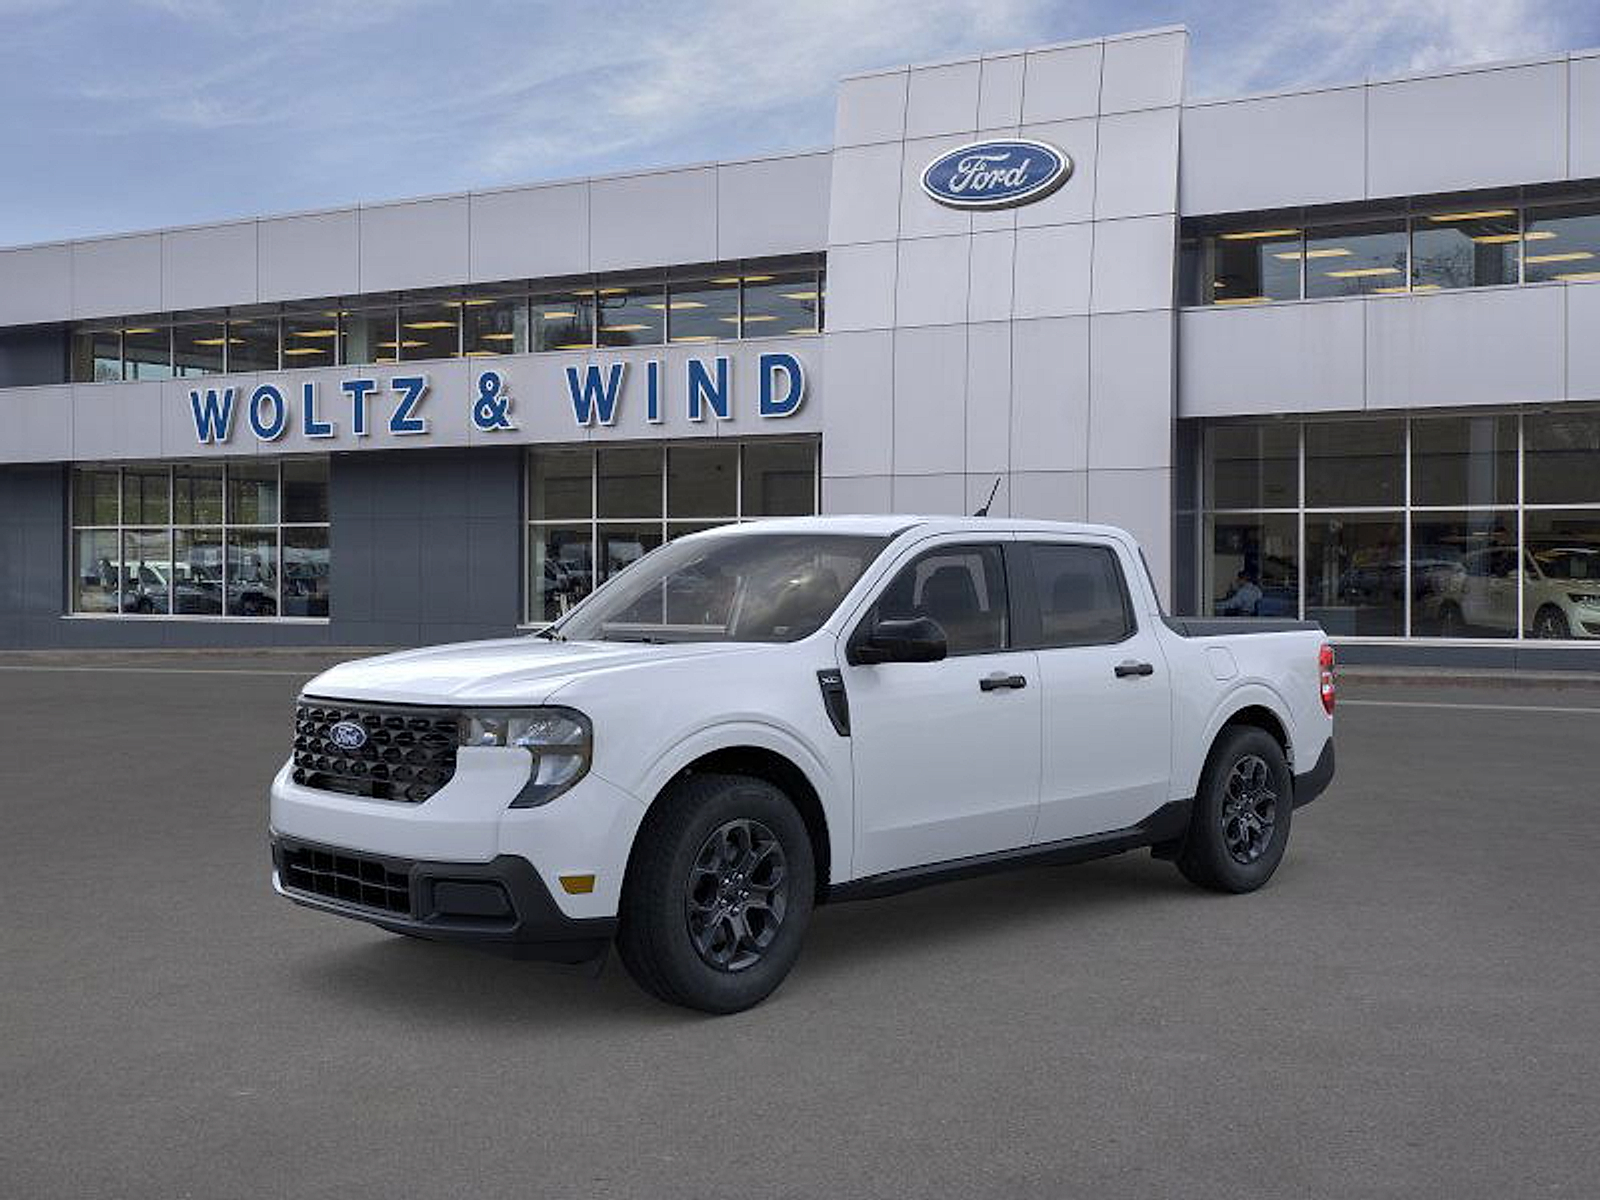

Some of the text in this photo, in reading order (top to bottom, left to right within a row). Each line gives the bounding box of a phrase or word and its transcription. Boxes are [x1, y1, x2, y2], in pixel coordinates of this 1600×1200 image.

[949, 152, 1031, 193] Ford
[189, 352, 805, 443] WOLTZ & WIND
